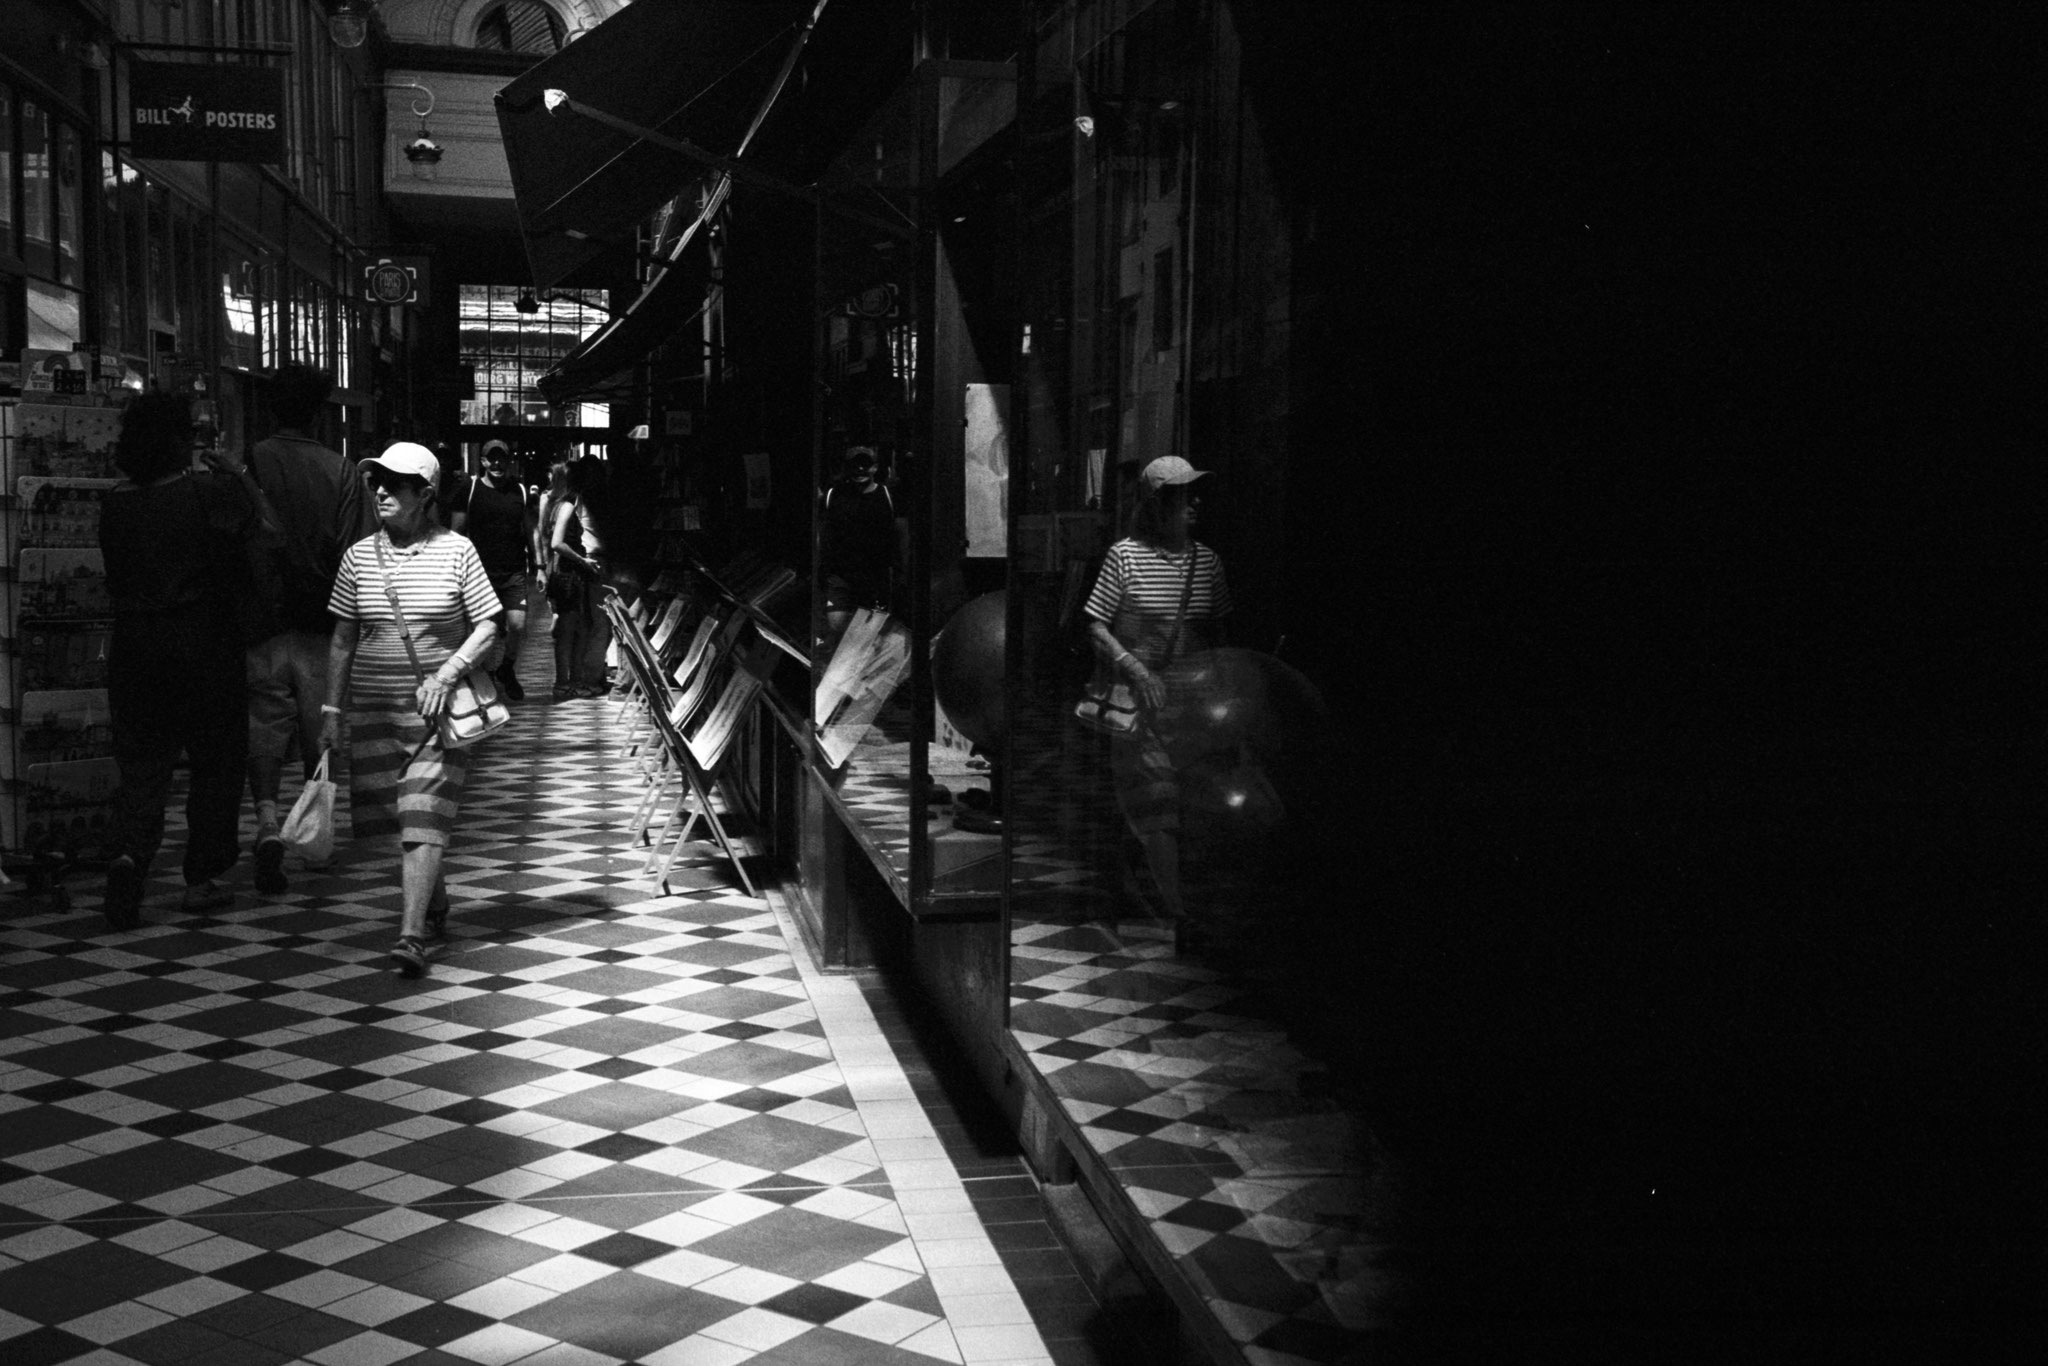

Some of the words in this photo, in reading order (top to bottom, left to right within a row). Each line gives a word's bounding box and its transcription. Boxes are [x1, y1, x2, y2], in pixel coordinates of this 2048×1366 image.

[135, 107, 171, 126] BILL
[205, 110, 277, 130] POSTERS
[379, 271, 401, 288] PARIS
[474, 372, 503, 384] OURG
